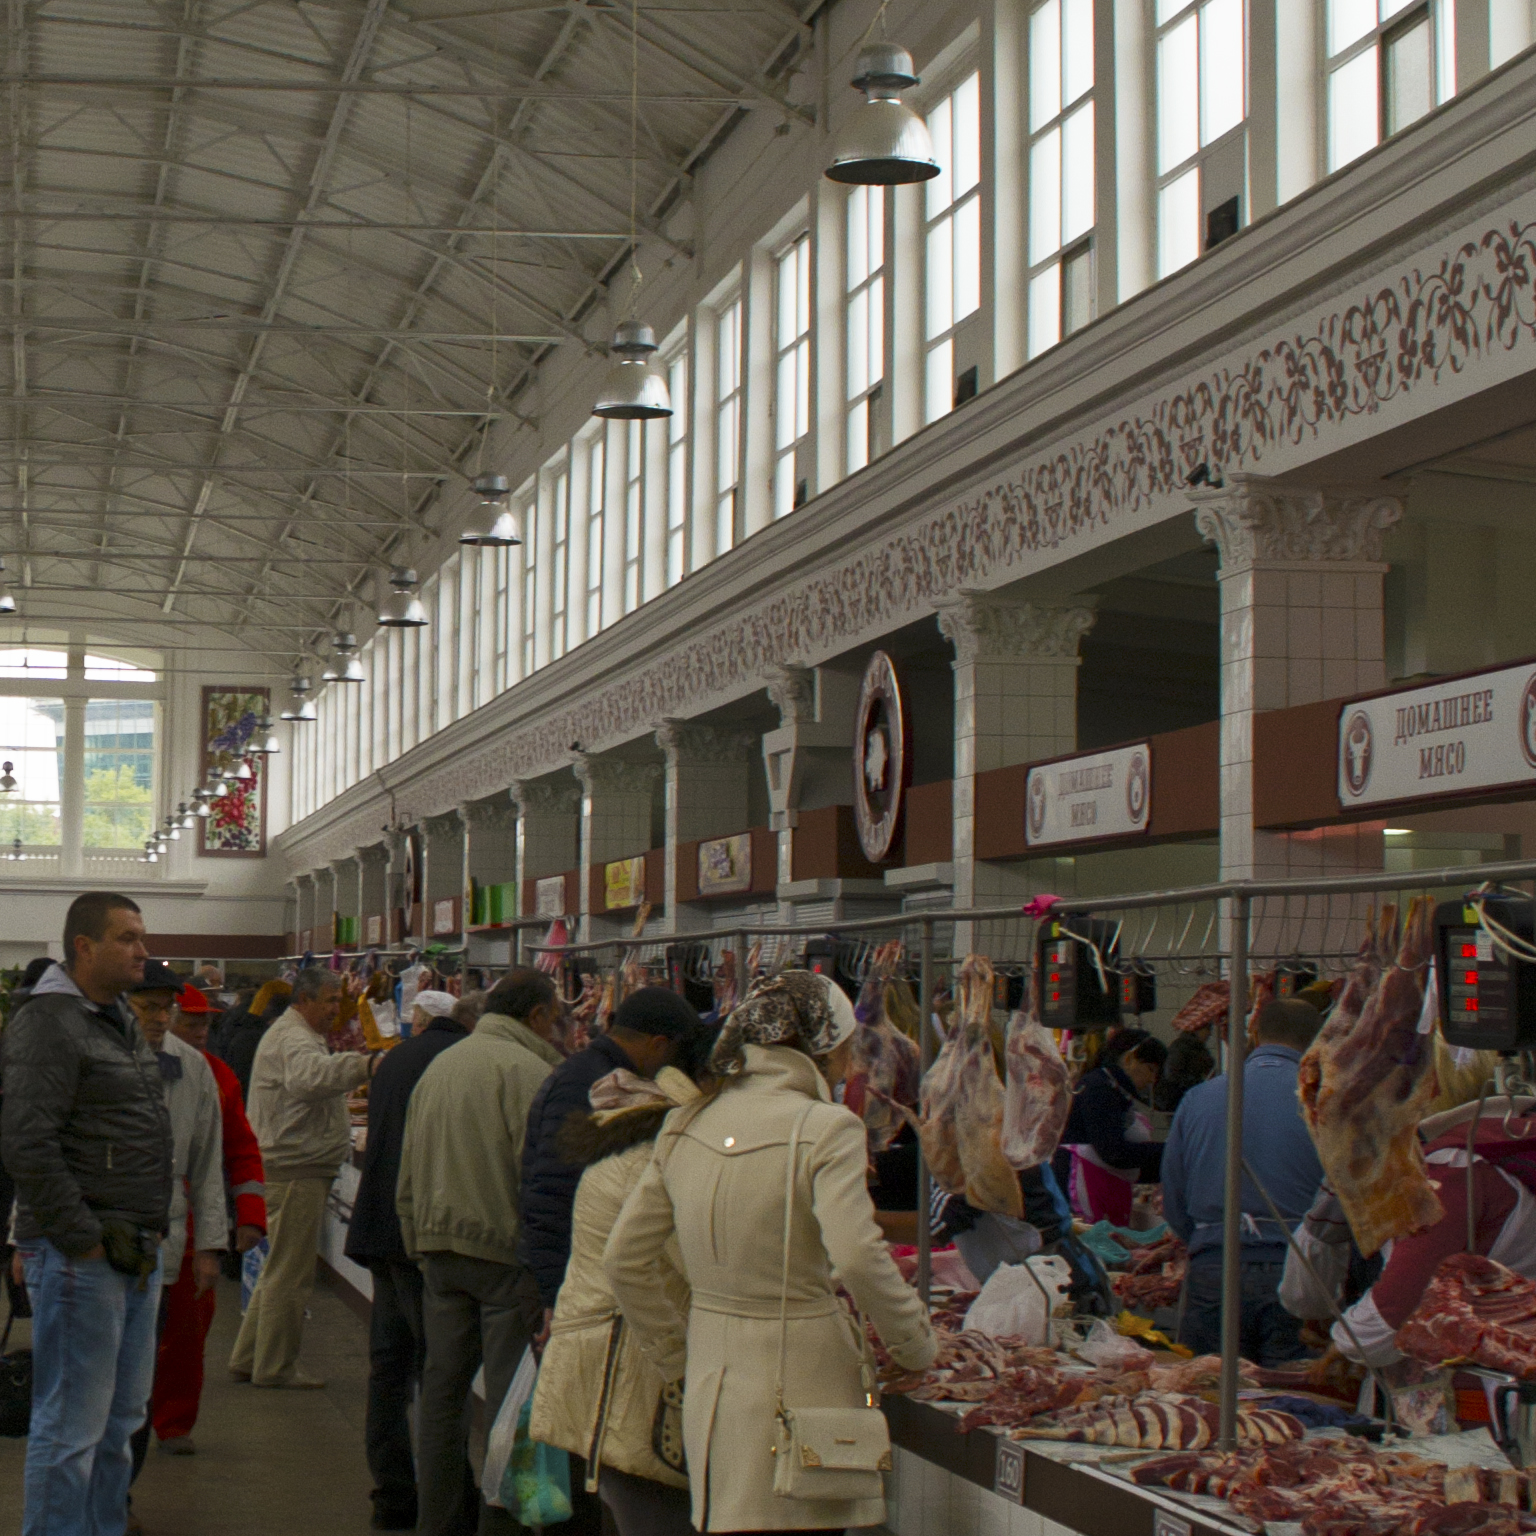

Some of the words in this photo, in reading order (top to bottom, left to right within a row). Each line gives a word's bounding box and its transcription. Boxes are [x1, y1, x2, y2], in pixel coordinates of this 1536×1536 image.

[1394, 688, 1494, 746] ДОМАШНЕЕ
[1418, 741, 1466, 780] МЯСО
[999, 1454, 1020, 1489] 160
